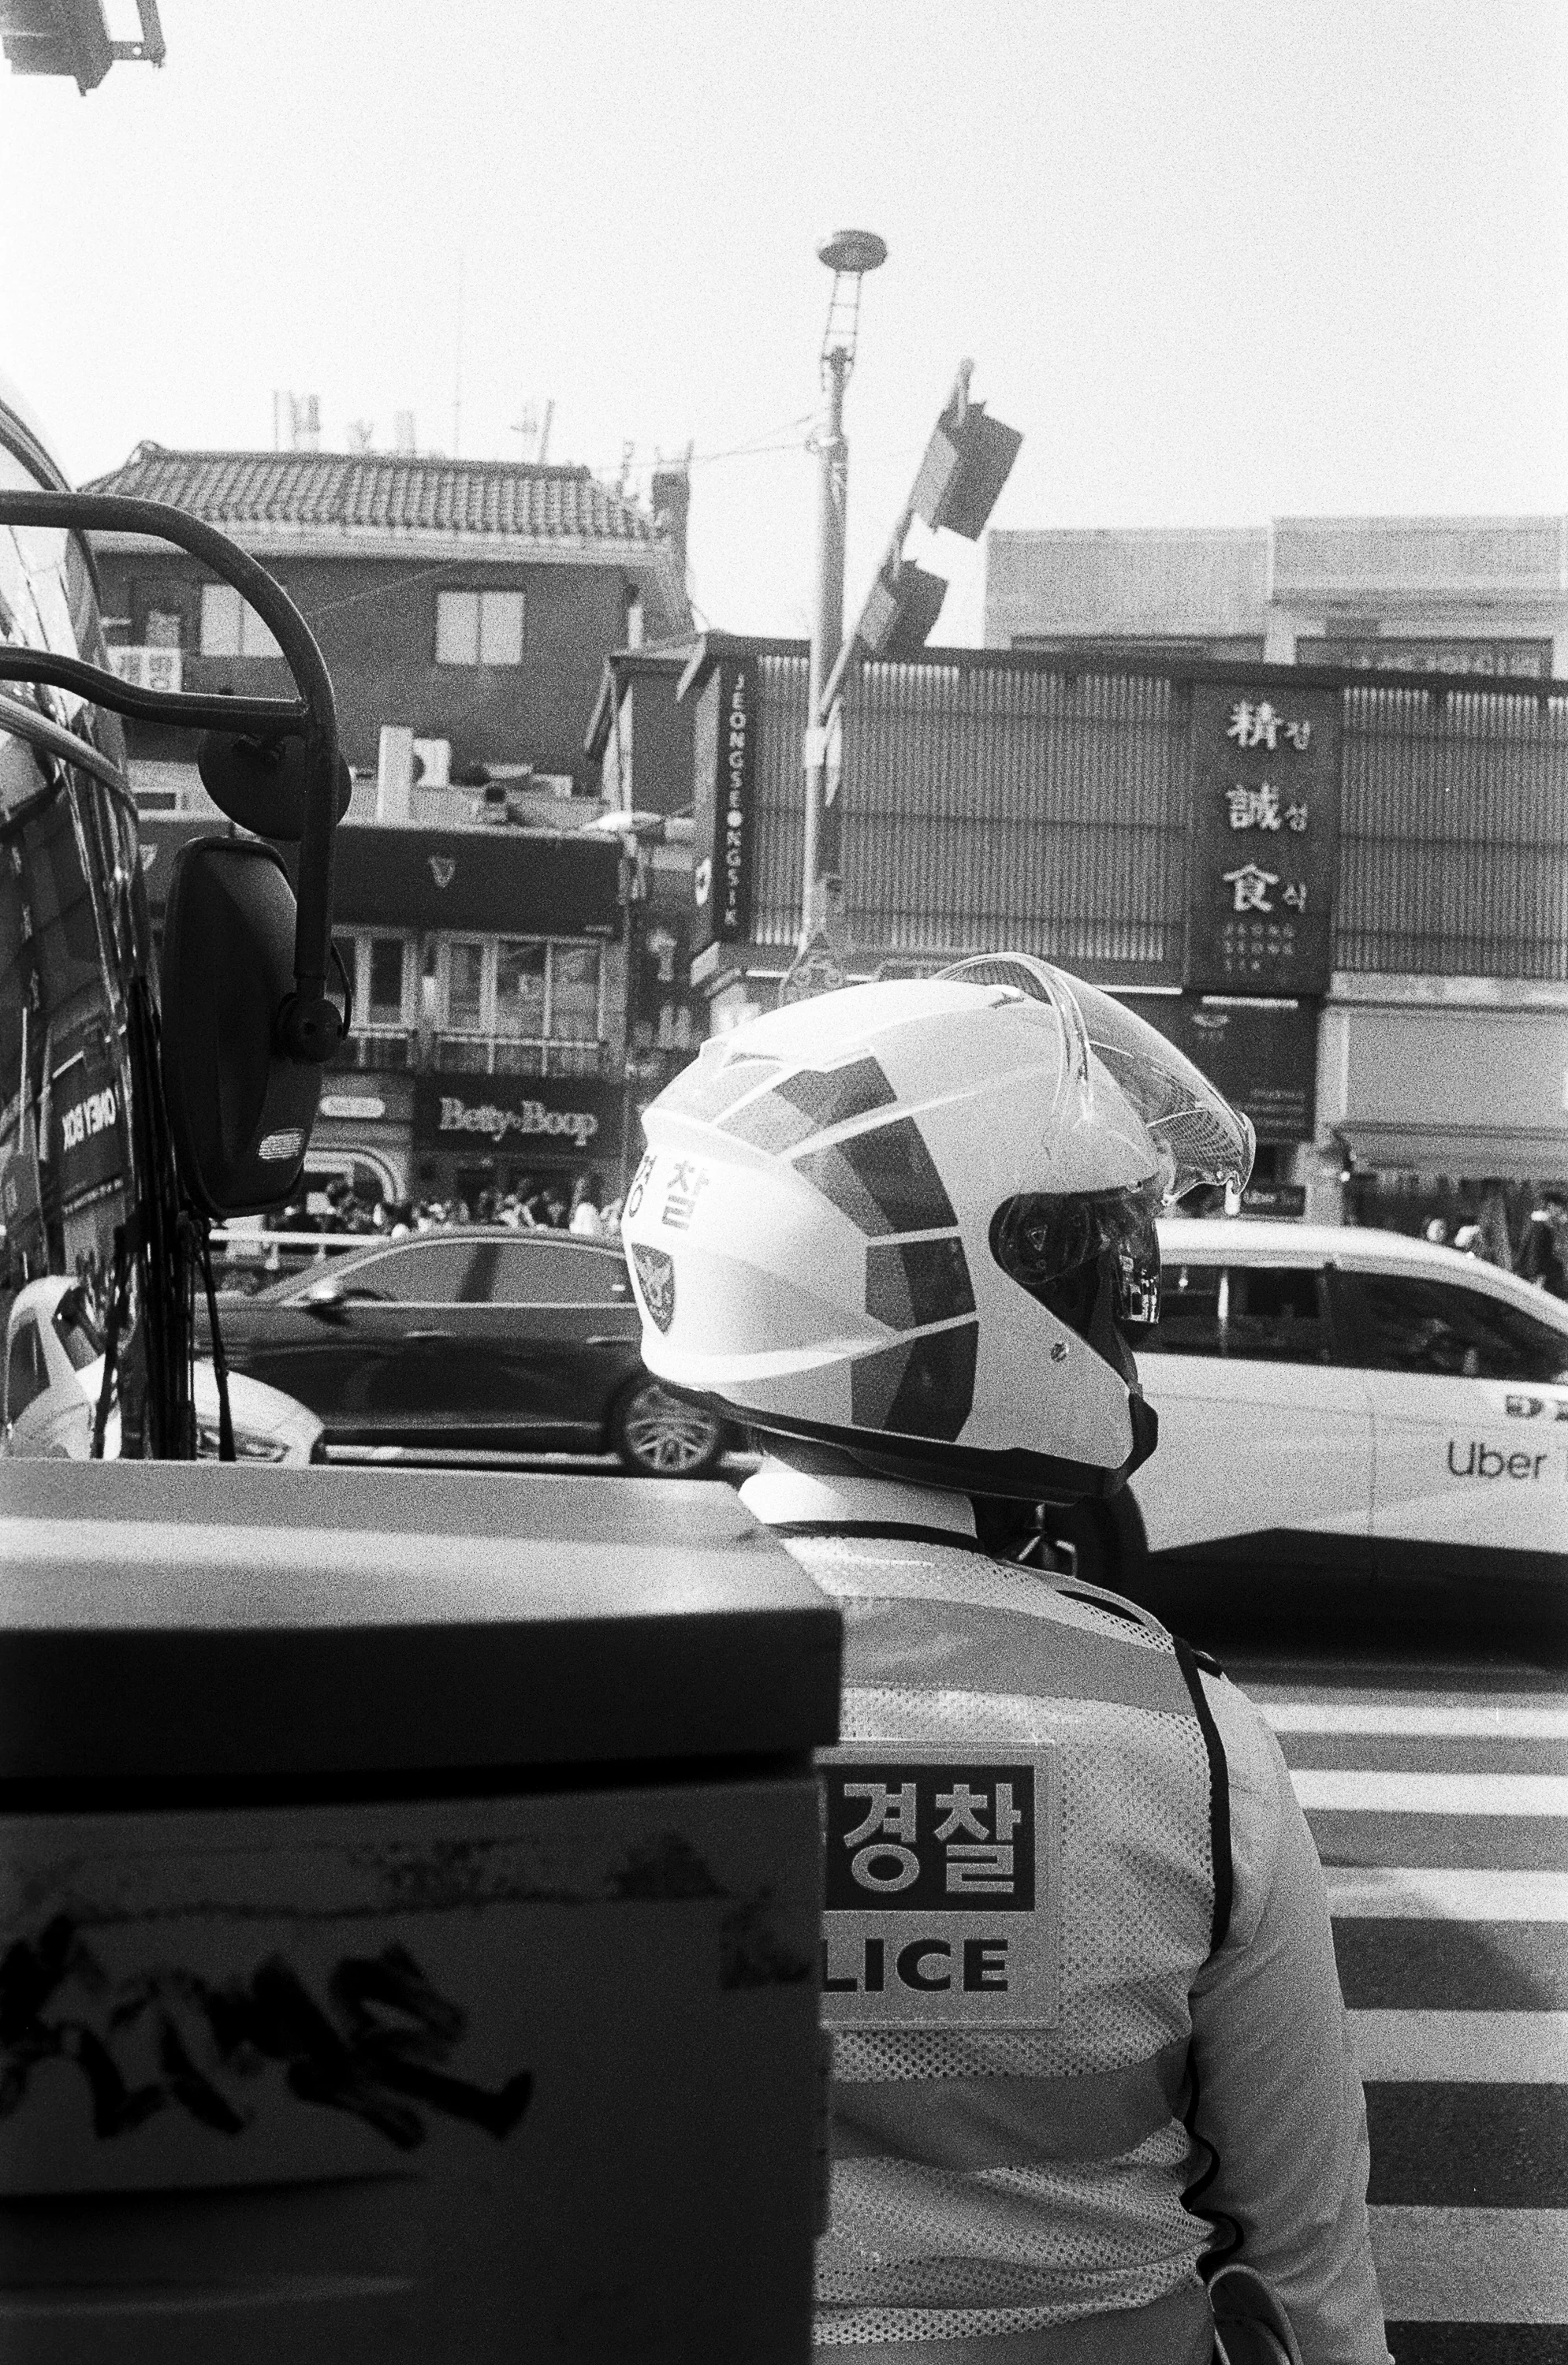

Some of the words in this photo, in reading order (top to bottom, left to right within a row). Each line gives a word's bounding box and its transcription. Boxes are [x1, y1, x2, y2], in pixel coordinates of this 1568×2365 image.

[520, 1099, 599, 1145] Boop
[1447, 1439, 1547, 1480] Uber
[843, 1782, 1022, 1893] 경찰
[821, 1938, 1008, 1993] LICE
